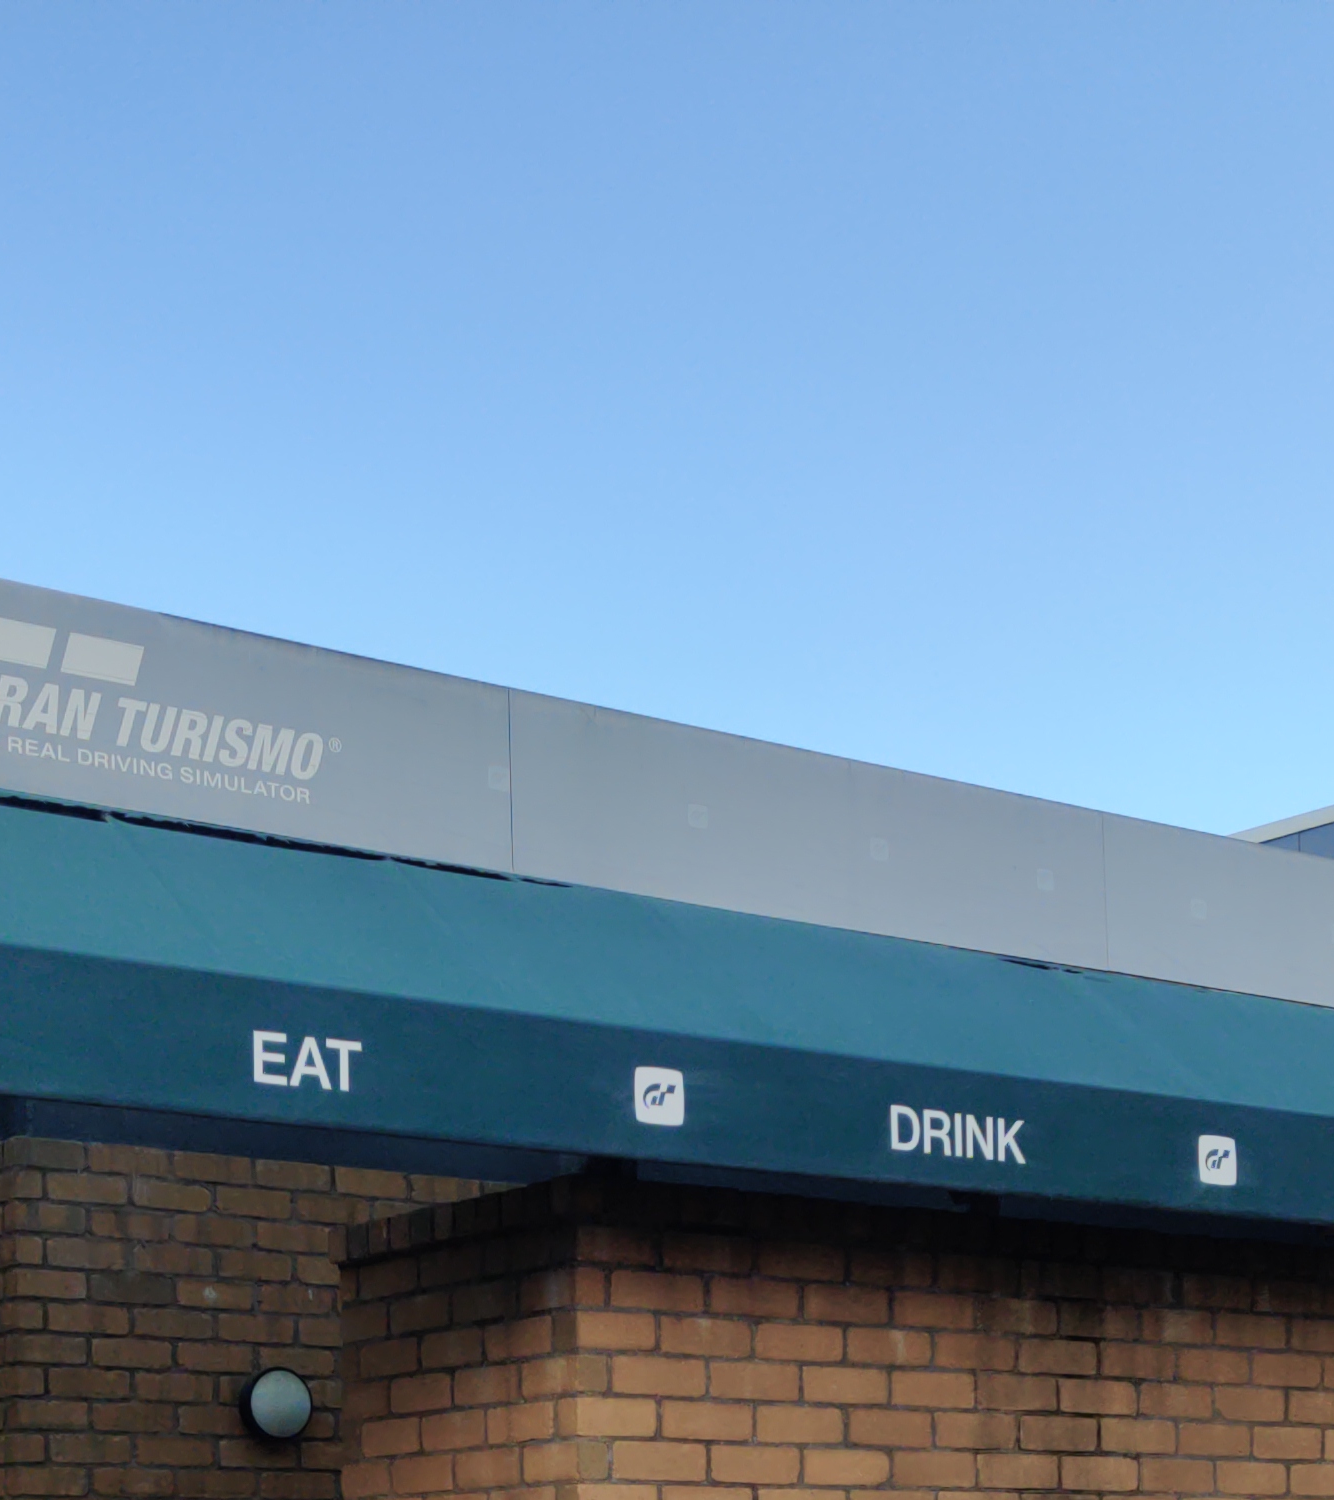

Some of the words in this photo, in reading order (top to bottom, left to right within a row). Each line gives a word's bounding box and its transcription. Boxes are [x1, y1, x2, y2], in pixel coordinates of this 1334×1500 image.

[7, 736, 70, 763] REAL
[77, 747, 174, 781] DRIVING
[179, 766, 311, 804] SIMULATOR
[252, 1030, 362, 1093] EAT
[890, 1104, 1027, 1165] DRINK
